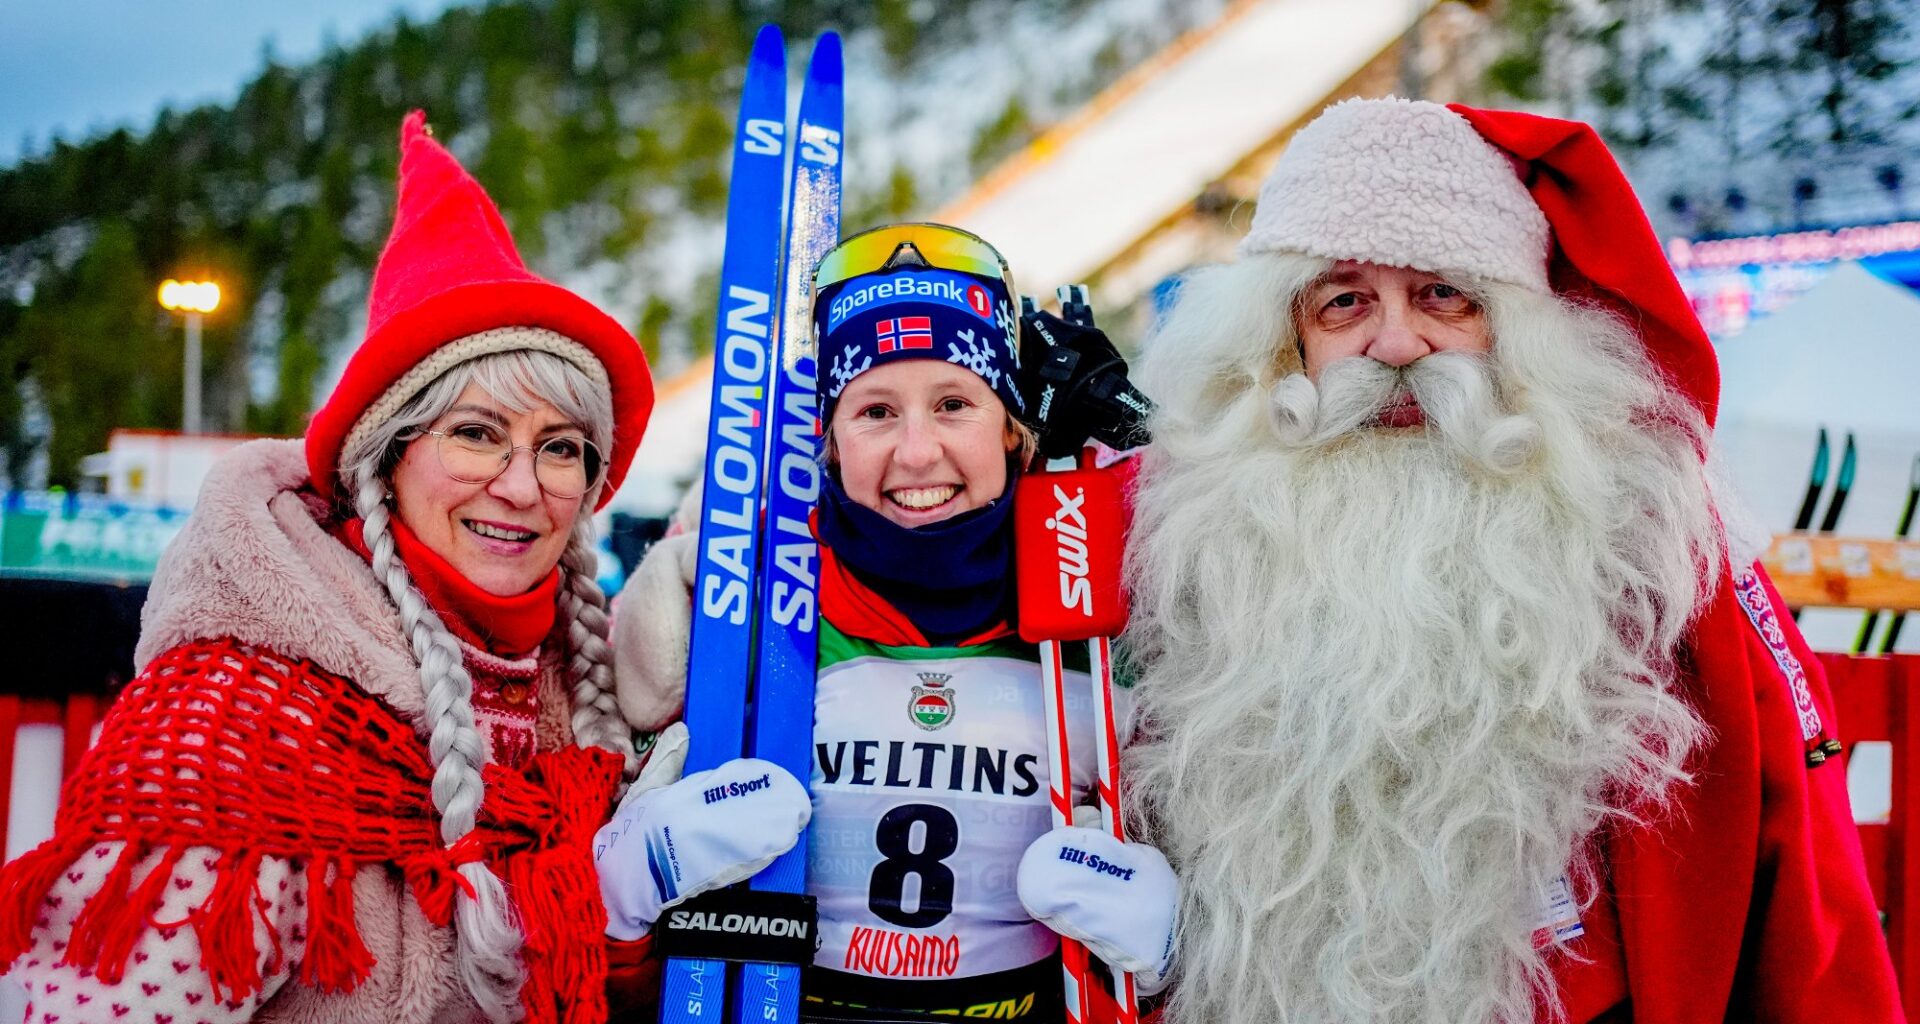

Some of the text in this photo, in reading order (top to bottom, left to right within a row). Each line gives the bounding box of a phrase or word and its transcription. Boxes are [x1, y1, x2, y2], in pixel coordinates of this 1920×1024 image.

[831, 277, 985, 323] SpareBank 1
[703, 285, 770, 625] SALOMON
[771, 356, 821, 633] SALOMO
[815, 741, 1039, 797] VELTINS
[664, 826, 673, 847] World
[869, 803, 958, 928] 8
[668, 911, 808, 939] SALOMON
[845, 926, 961, 977] KUUSAMO
